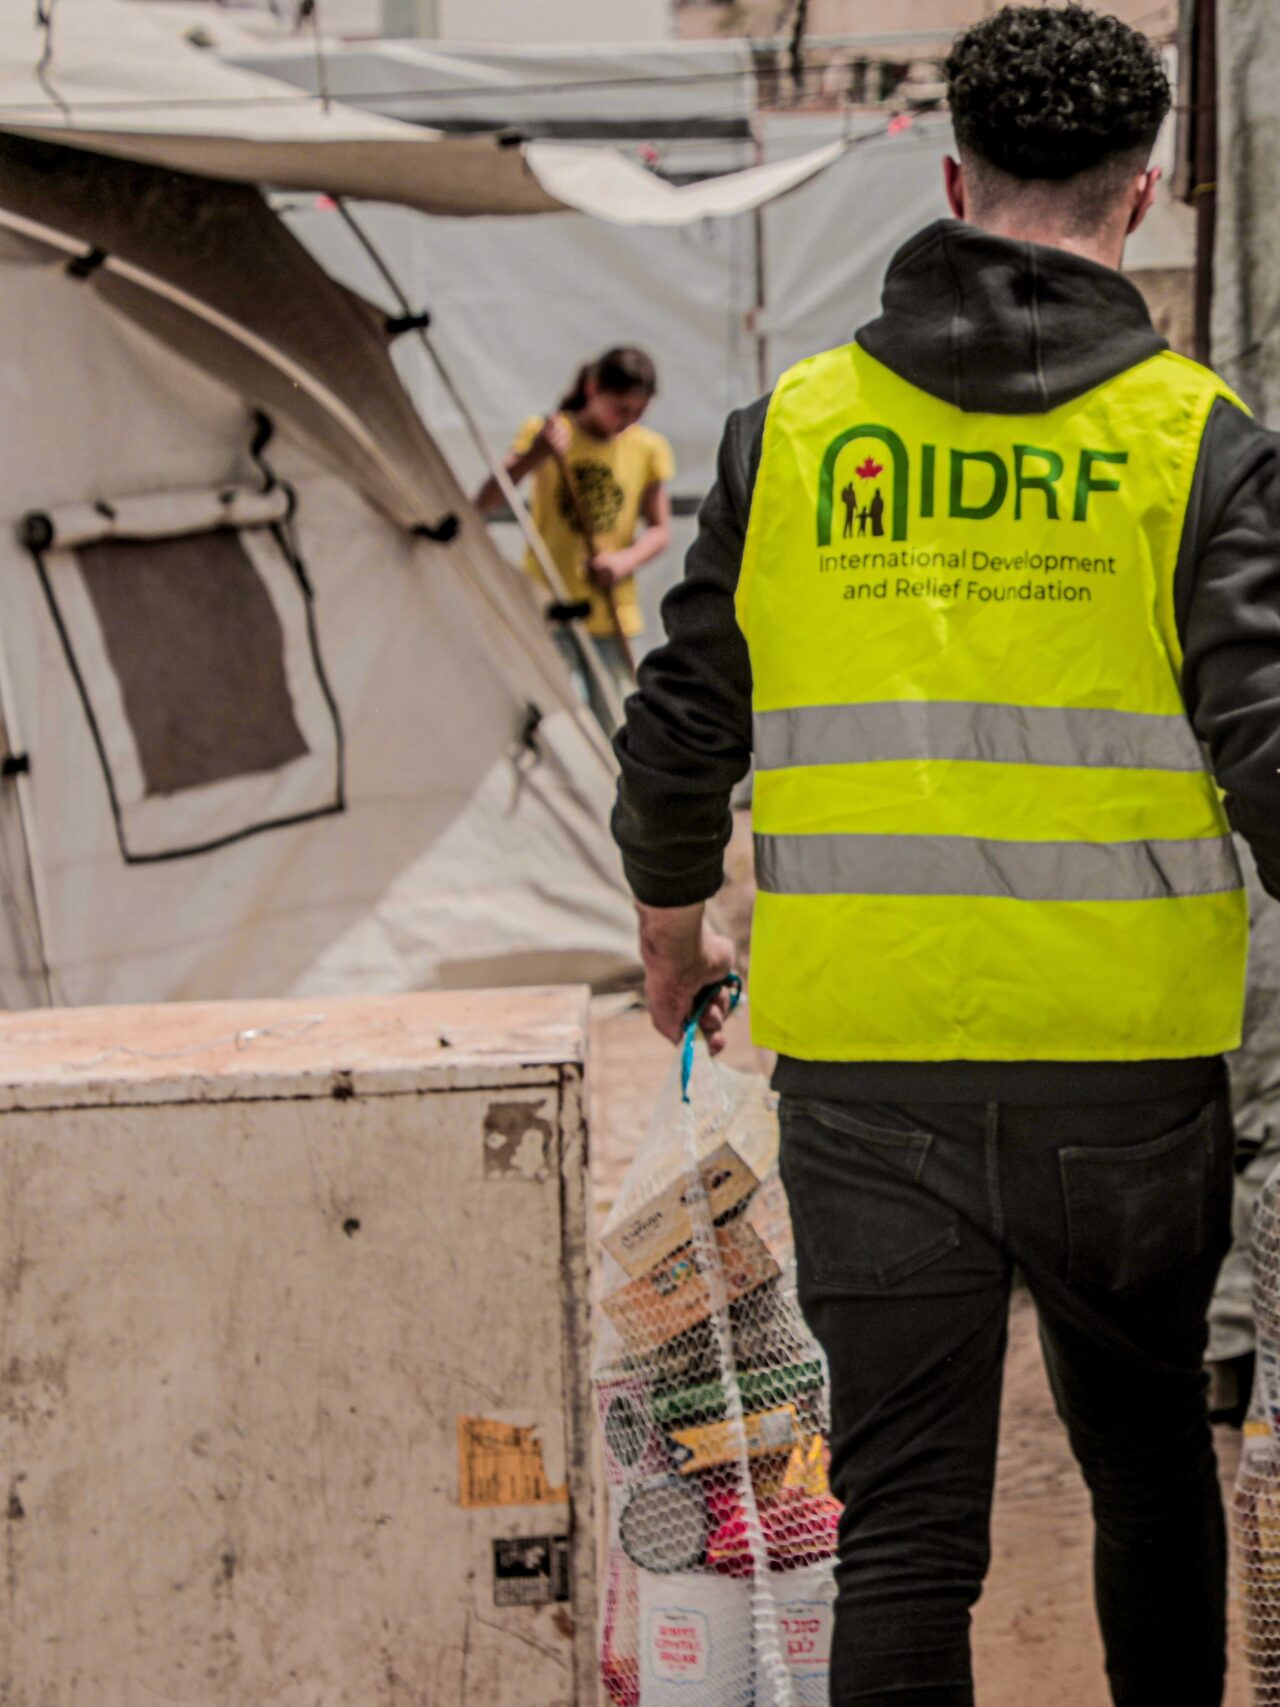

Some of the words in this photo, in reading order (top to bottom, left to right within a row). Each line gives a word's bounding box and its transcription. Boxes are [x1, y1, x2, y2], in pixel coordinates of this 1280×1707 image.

[920, 444, 1129, 521] IDRF
[819, 548, 966, 573] International
[972, 550, 1116, 575] Development
[843, 579, 887, 600] and
[895, 578, 961, 599] Relief
[966, 581, 1092, 602] Foundation
